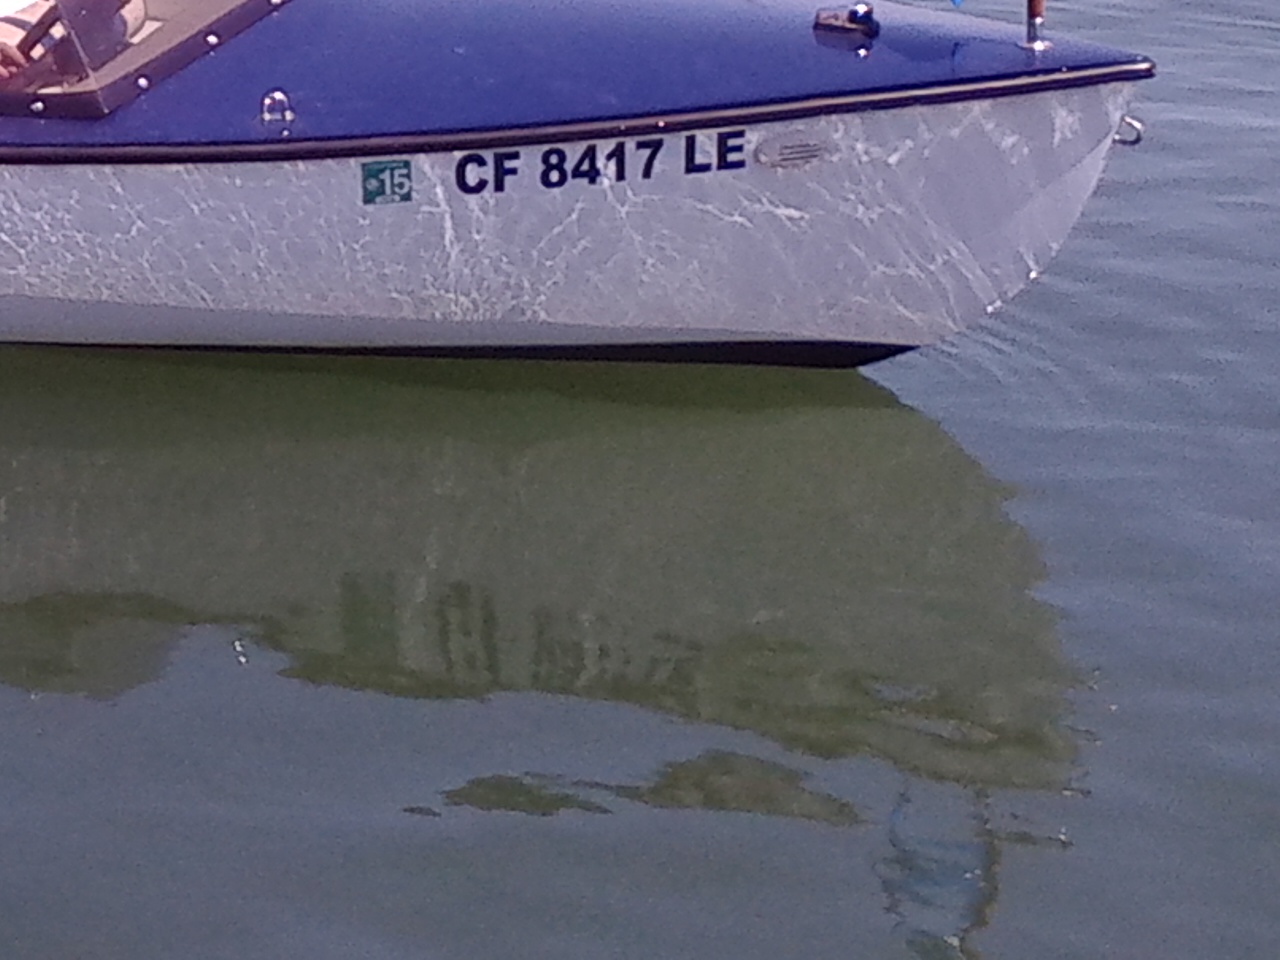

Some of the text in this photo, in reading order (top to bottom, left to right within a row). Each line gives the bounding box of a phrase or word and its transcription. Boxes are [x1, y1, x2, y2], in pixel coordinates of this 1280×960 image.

[379, 168, 411, 195] 15
[455, 129, 746, 194] CF 8417 LE
